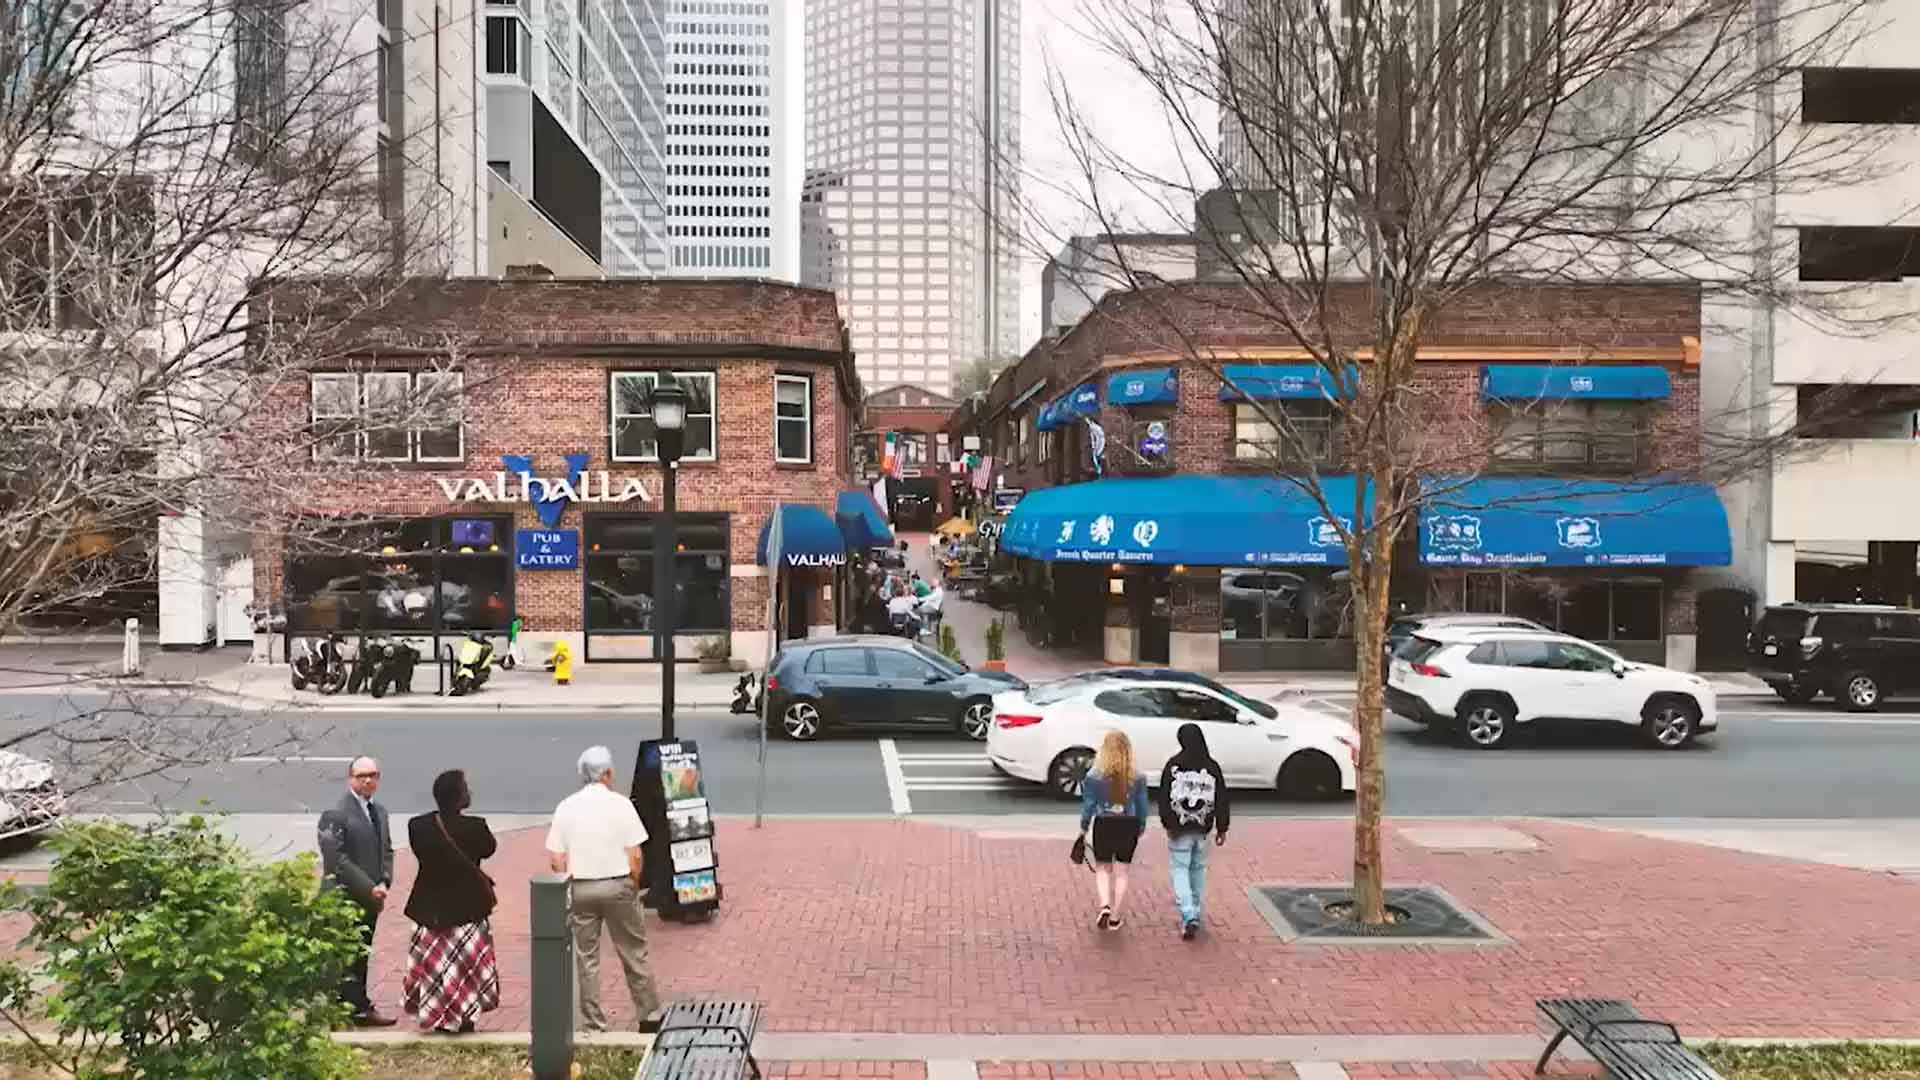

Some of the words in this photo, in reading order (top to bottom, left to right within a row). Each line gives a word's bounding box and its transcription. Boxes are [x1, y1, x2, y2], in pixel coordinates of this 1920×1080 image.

[532, 532, 561, 544] PUB
[540, 544, 551, 554] &
[1081, 549, 1116, 561] Quarter
[1117, 550, 1154, 561] Tavern
